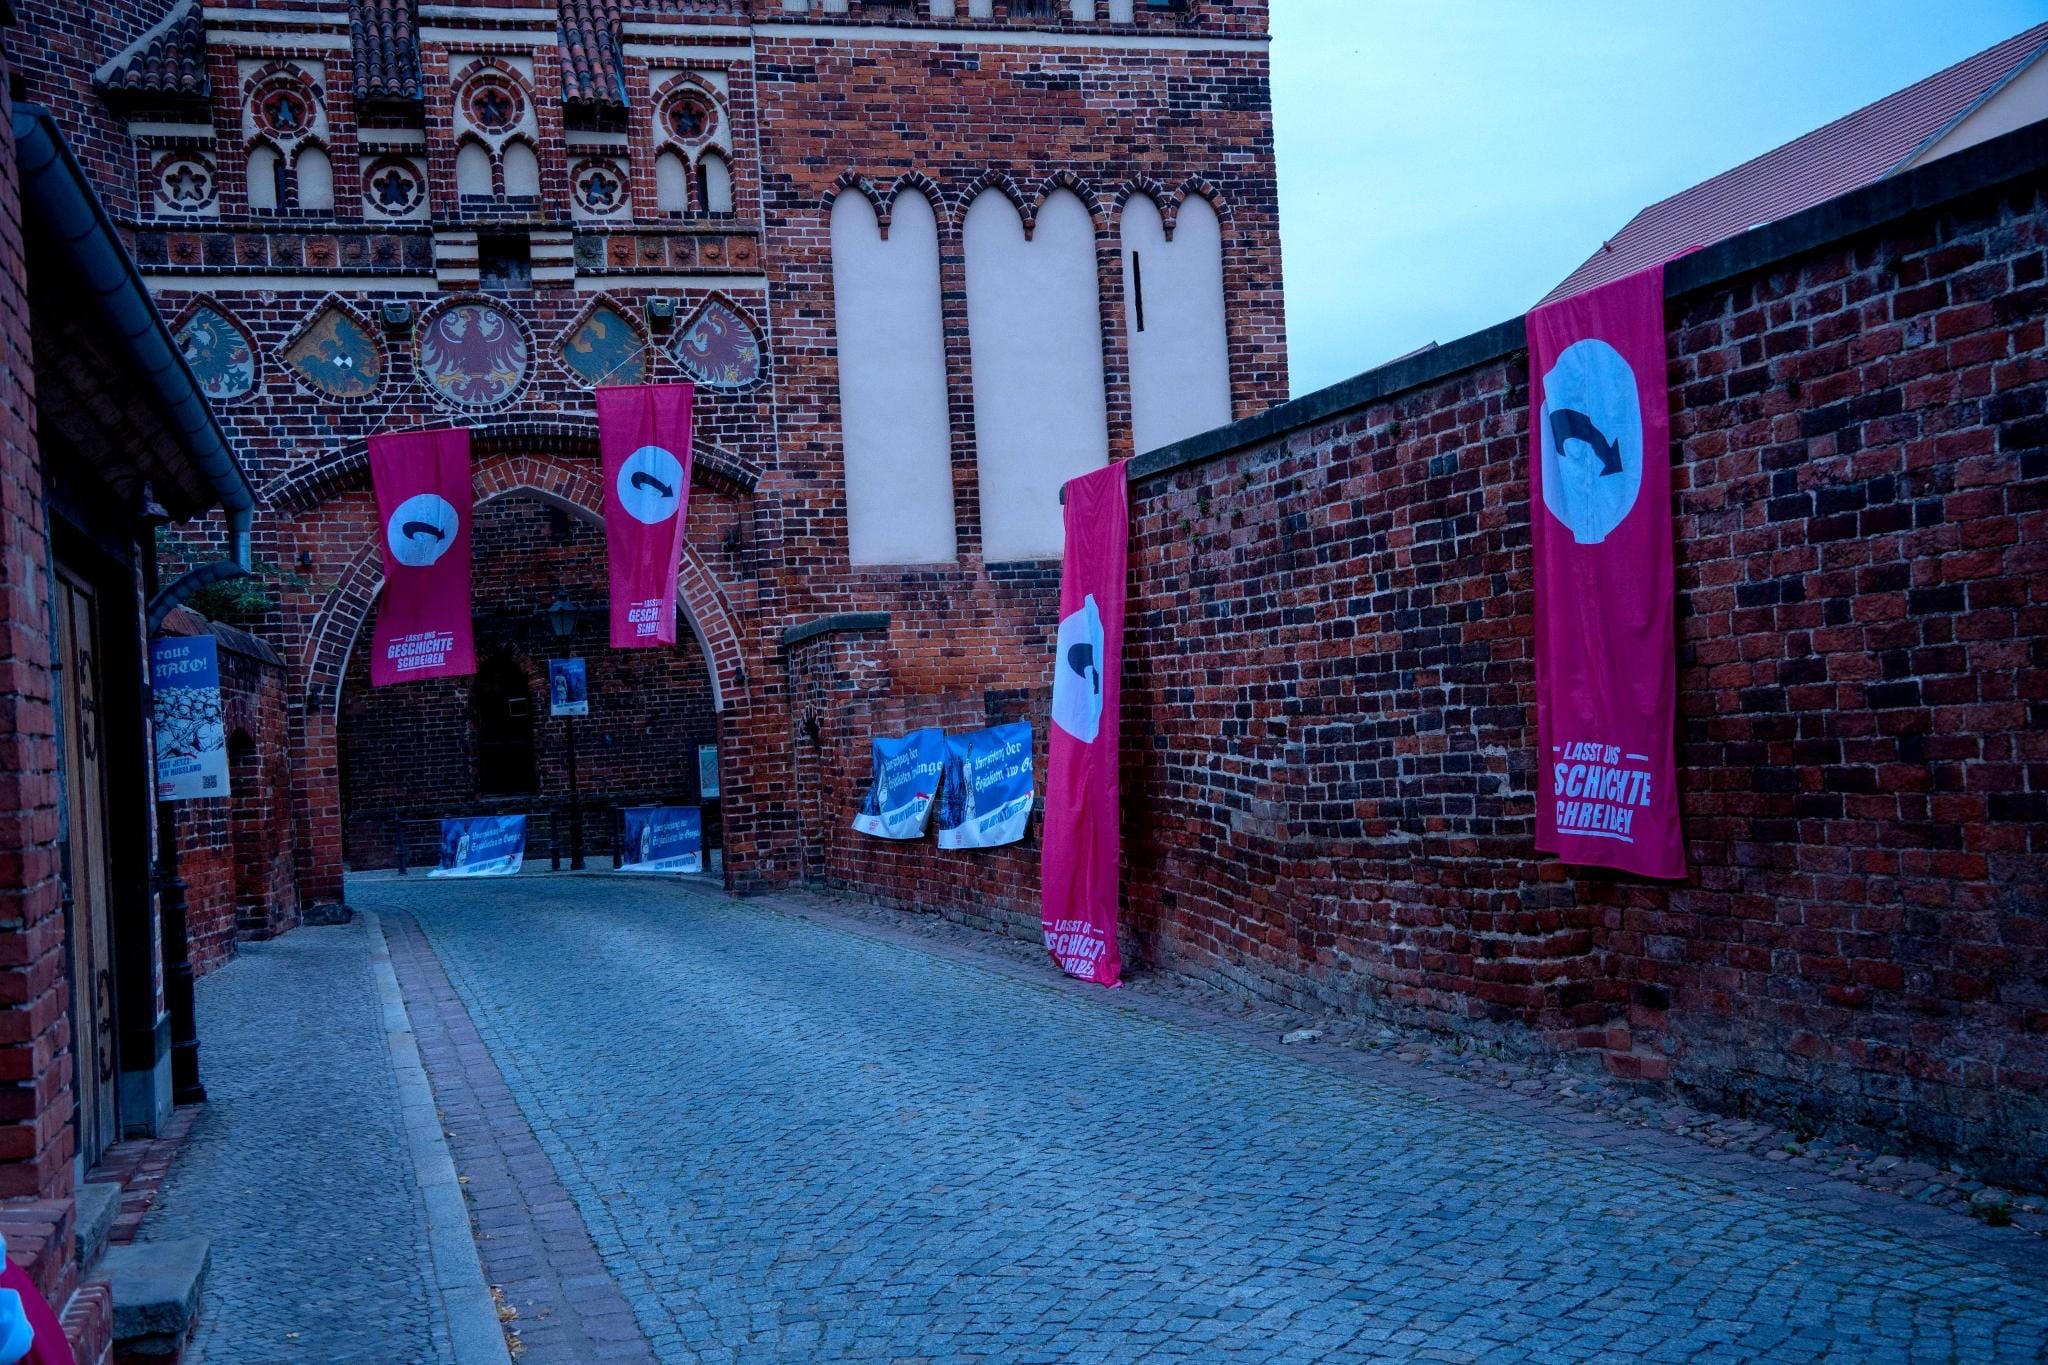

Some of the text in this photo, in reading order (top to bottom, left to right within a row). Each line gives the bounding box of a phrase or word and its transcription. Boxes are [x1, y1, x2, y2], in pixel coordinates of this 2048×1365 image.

[404, 633, 423, 642] LASST
[156, 646, 190, 660] raus
[387, 637, 454, 659] GESCHICHTE
[155, 657, 208, 679] NATO!
[397, 652, 445, 669] SCHREIBEN
[1006, 742, 1022, 756] der
[1562, 741, 1603, 762] LASST
[1554, 762, 1652, 807] SCHICHTE
[1054, 919, 1083, 933] LASST
